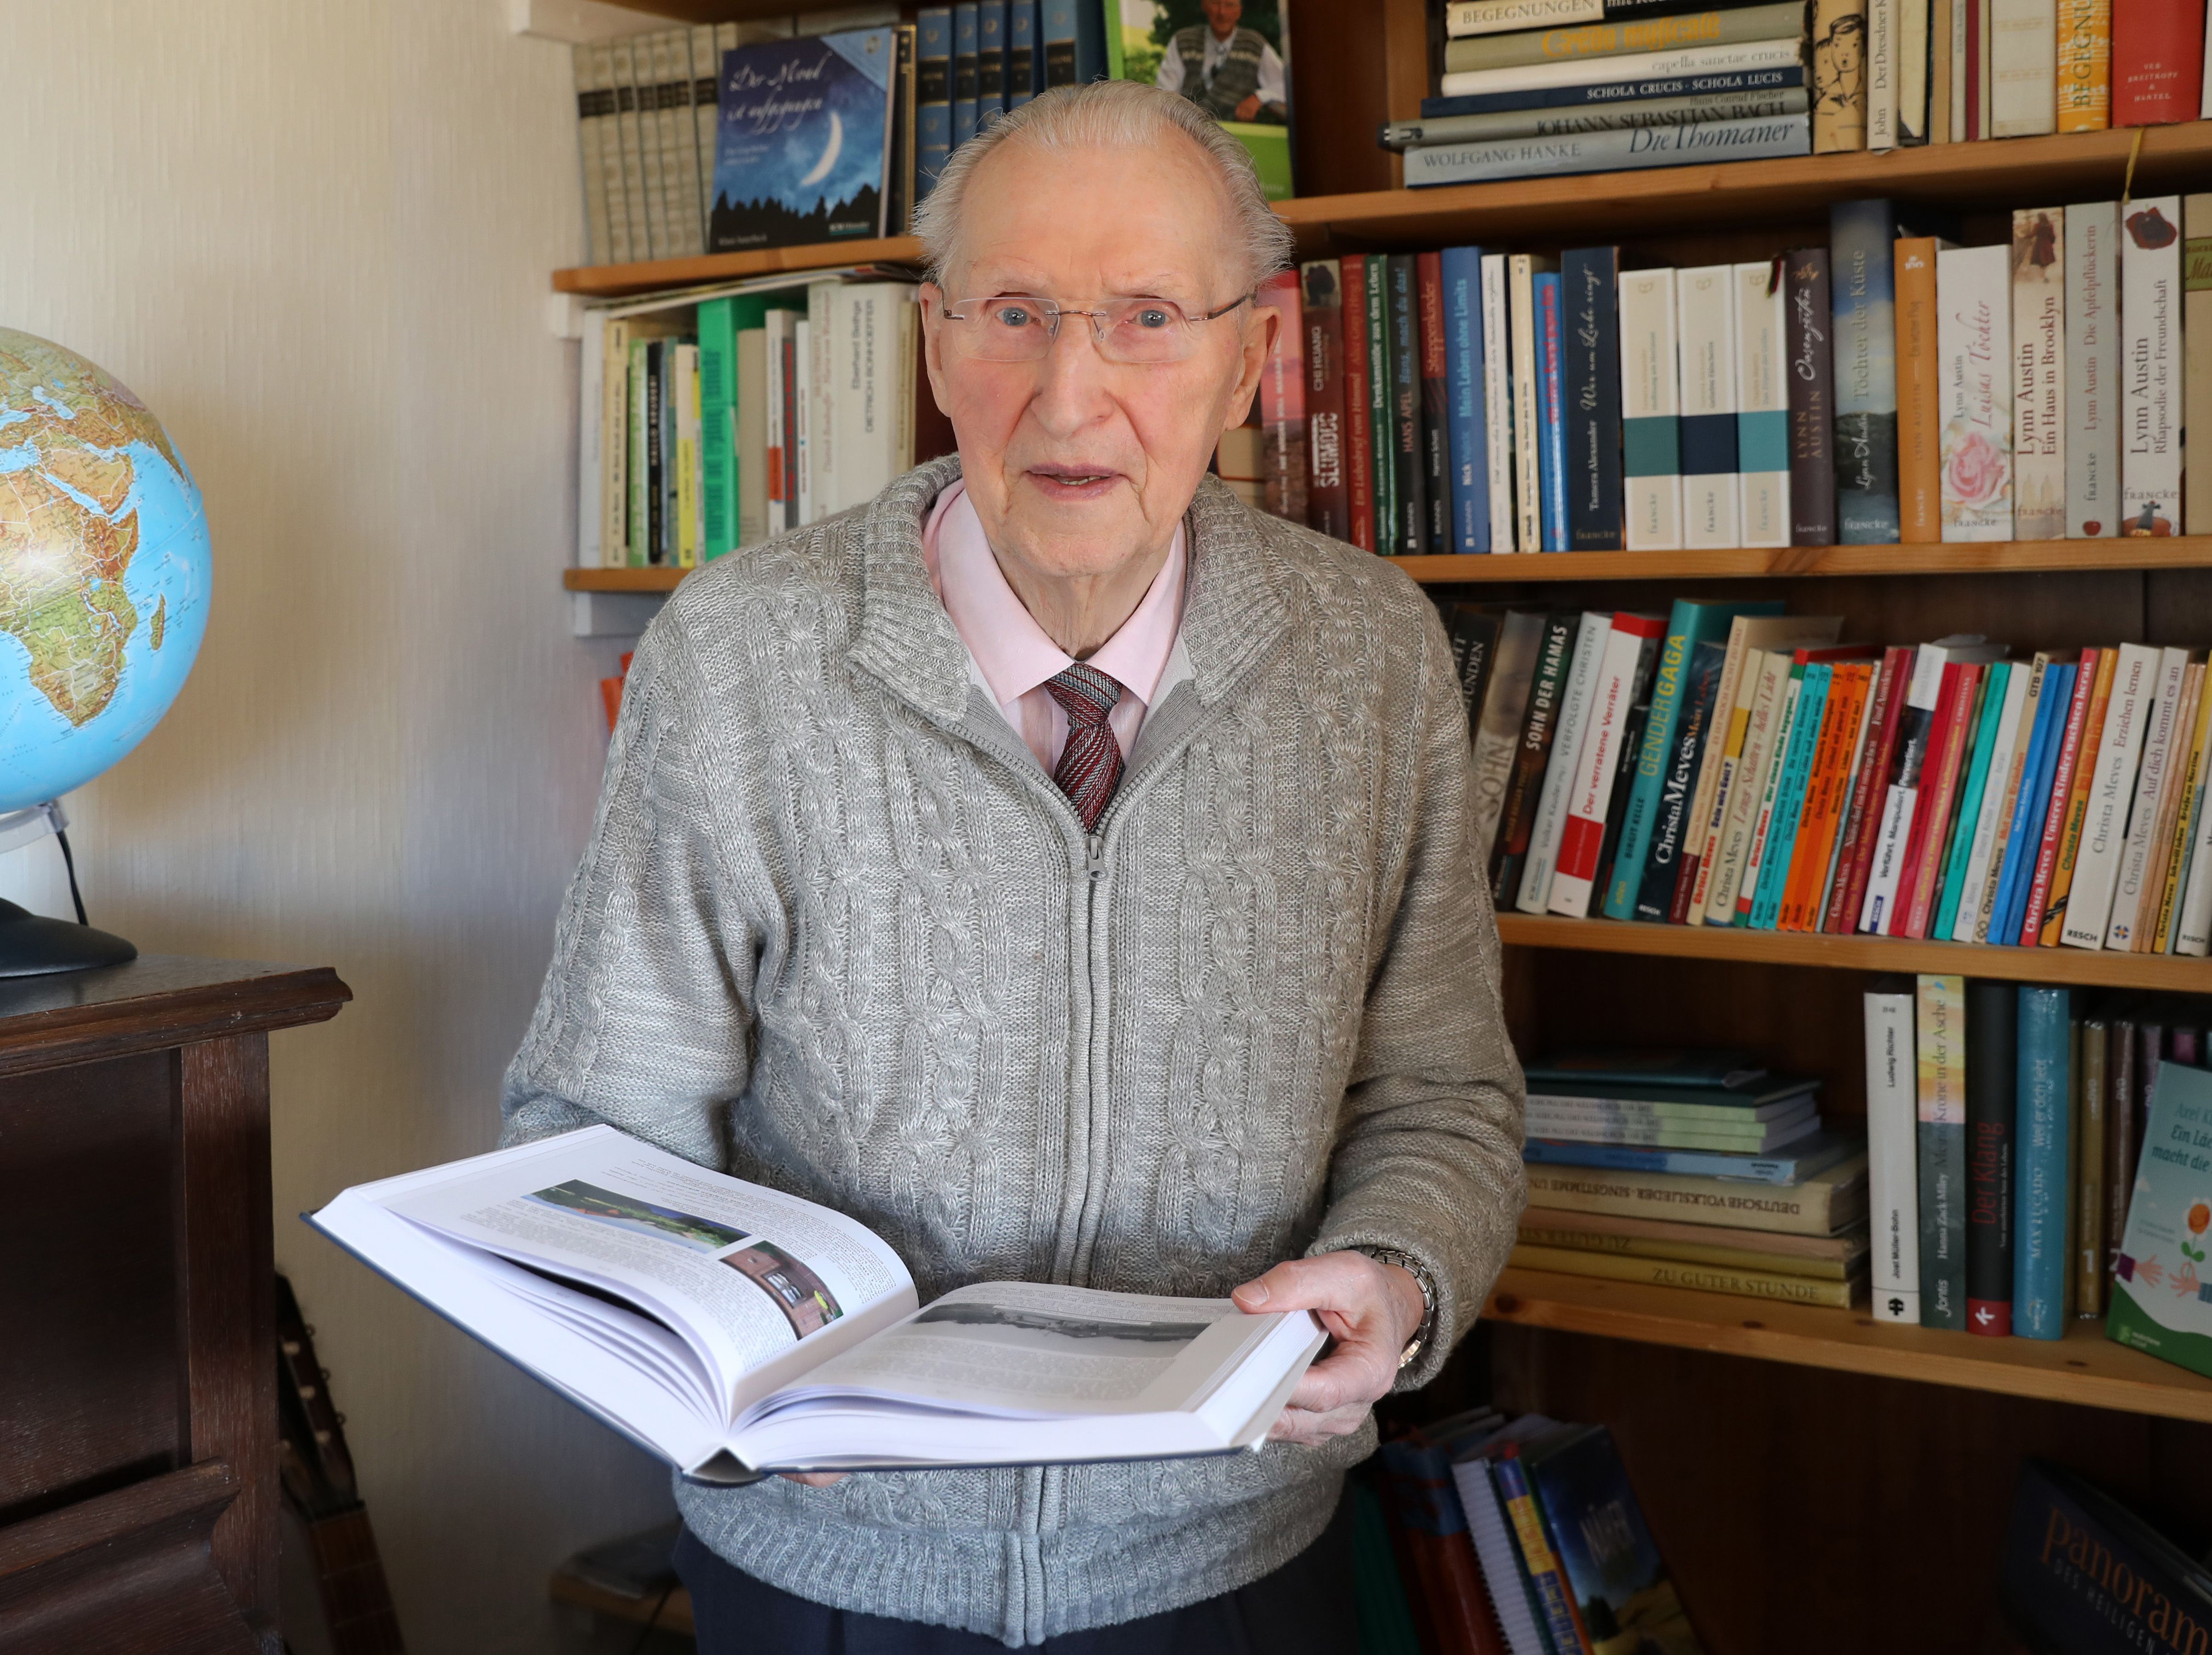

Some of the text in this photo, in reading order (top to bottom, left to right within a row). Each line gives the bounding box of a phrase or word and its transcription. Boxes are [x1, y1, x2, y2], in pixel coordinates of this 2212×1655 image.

[1462, 0, 1595, 24] BEGEGNUNGEN
[1587, 72, 1783, 100] SCHOLA CRUCIS SCHOLA LUCIS
[1874, 10, 1888, 136] John Der Dresdner
[1535, 100, 1785, 137] JOHANN SEBASTIAN BACH
[1628, 114, 1794, 153] Die Thomaner
[1422, 142, 1582, 168] WOLFGANG HANKE
[1370, 263, 1379, 295] Leben
[1456, 279, 1468, 317] Limits
[1371, 297, 1380, 320] dem
[1848, 250, 1870, 401] Töchter der Küste
[2083, 225, 2100, 430] Lynn Austin Die Apfelpflückerin
[1458, 320, 1469, 348] ohne
[1577, 263, 1601, 410] Wer um Liebe ringt
[1458, 349, 1470, 385] Leben
[1952, 355, 1969, 418] Lynn Austin
[1967, 299, 1992, 429] Luisas Töchter
[2040, 296, 2061, 455] Ein Haus in Brooklyn
[2153, 279, 2172, 455] Rhapsodie der Freundschaft
[1459, 387, 1472, 417] Mein
[1912, 384, 1921, 427] AUSTIN
[2016, 342, 2041, 455] Lynn Austin
[2130, 337, 2155, 454] Lynn Austin
[1400, 391, 1414, 453] HANS APEL
[1796, 411, 1807, 458] LYNN
[1809, 389, 1823, 458] AUSTIN
[1588, 420, 1599, 511] Tamera Alexander
[1854, 459, 1877, 490] Lynn
[2083, 453, 2096, 501] francke
[1703, 491, 1715, 533] francke
[2123, 486, 2177, 500] francke
[1953, 515, 1997, 527] francke
[1525, 624, 1569, 751] SOHN DER HAMAS
[1559, 626, 1595, 758] VERFOLGTE CHRISTEN
[2029, 676, 2041, 698] GTB
[2123, 659, 2143, 696] lernen
[1581, 675, 1620, 816] Der verratene Verräter
[2112, 698, 2135, 748] Erziehen
[1471, 742, 1514, 823] SOHN
[2024, 886, 2044, 934] Christa
[2035, 849, 2052, 886] Meves
[2044, 798, 2062, 843] Unsere
[2053, 752, 2072, 799] Kinder
[2063, 700, 2083, 753] wachsen
[2075, 661, 2092, 700] heran
[2102, 755, 2123, 800] Meves
[2122, 666, 2179, 896] Christa Meves Auf dich kommt es an
[1725, 831, 1743, 867] Meves
[2061, 799, 2084, 871] Christa Meves
[2091, 802, 2113, 854] Christa
[1981, 846, 2004, 915] Christa Meves
[2157, 784, 2193, 938] Christa Meves will an
[1716, 867, 1735, 908] Christa
[2066, 929, 2098, 942] RESCH
[1886, 1057, 1896, 1088] Ludwig
[1931, 999, 1947, 1121] Krone in der Asche
[2151, 1143, 2211, 1172] macht die
[2170, 1124, 2192, 1144] Ein
[1973, 1121, 2006, 1225] Der Klang
[1552, 1180, 1800, 1216] DEUTSCHE VOLKSLIEDER SINGSTIMME
[1937, 1228, 1948, 1258] Hanna
[1651, 1267, 1819, 1300] ZU GUTER STUNDE
[2040, 1504, 2212, 1655] panoram
